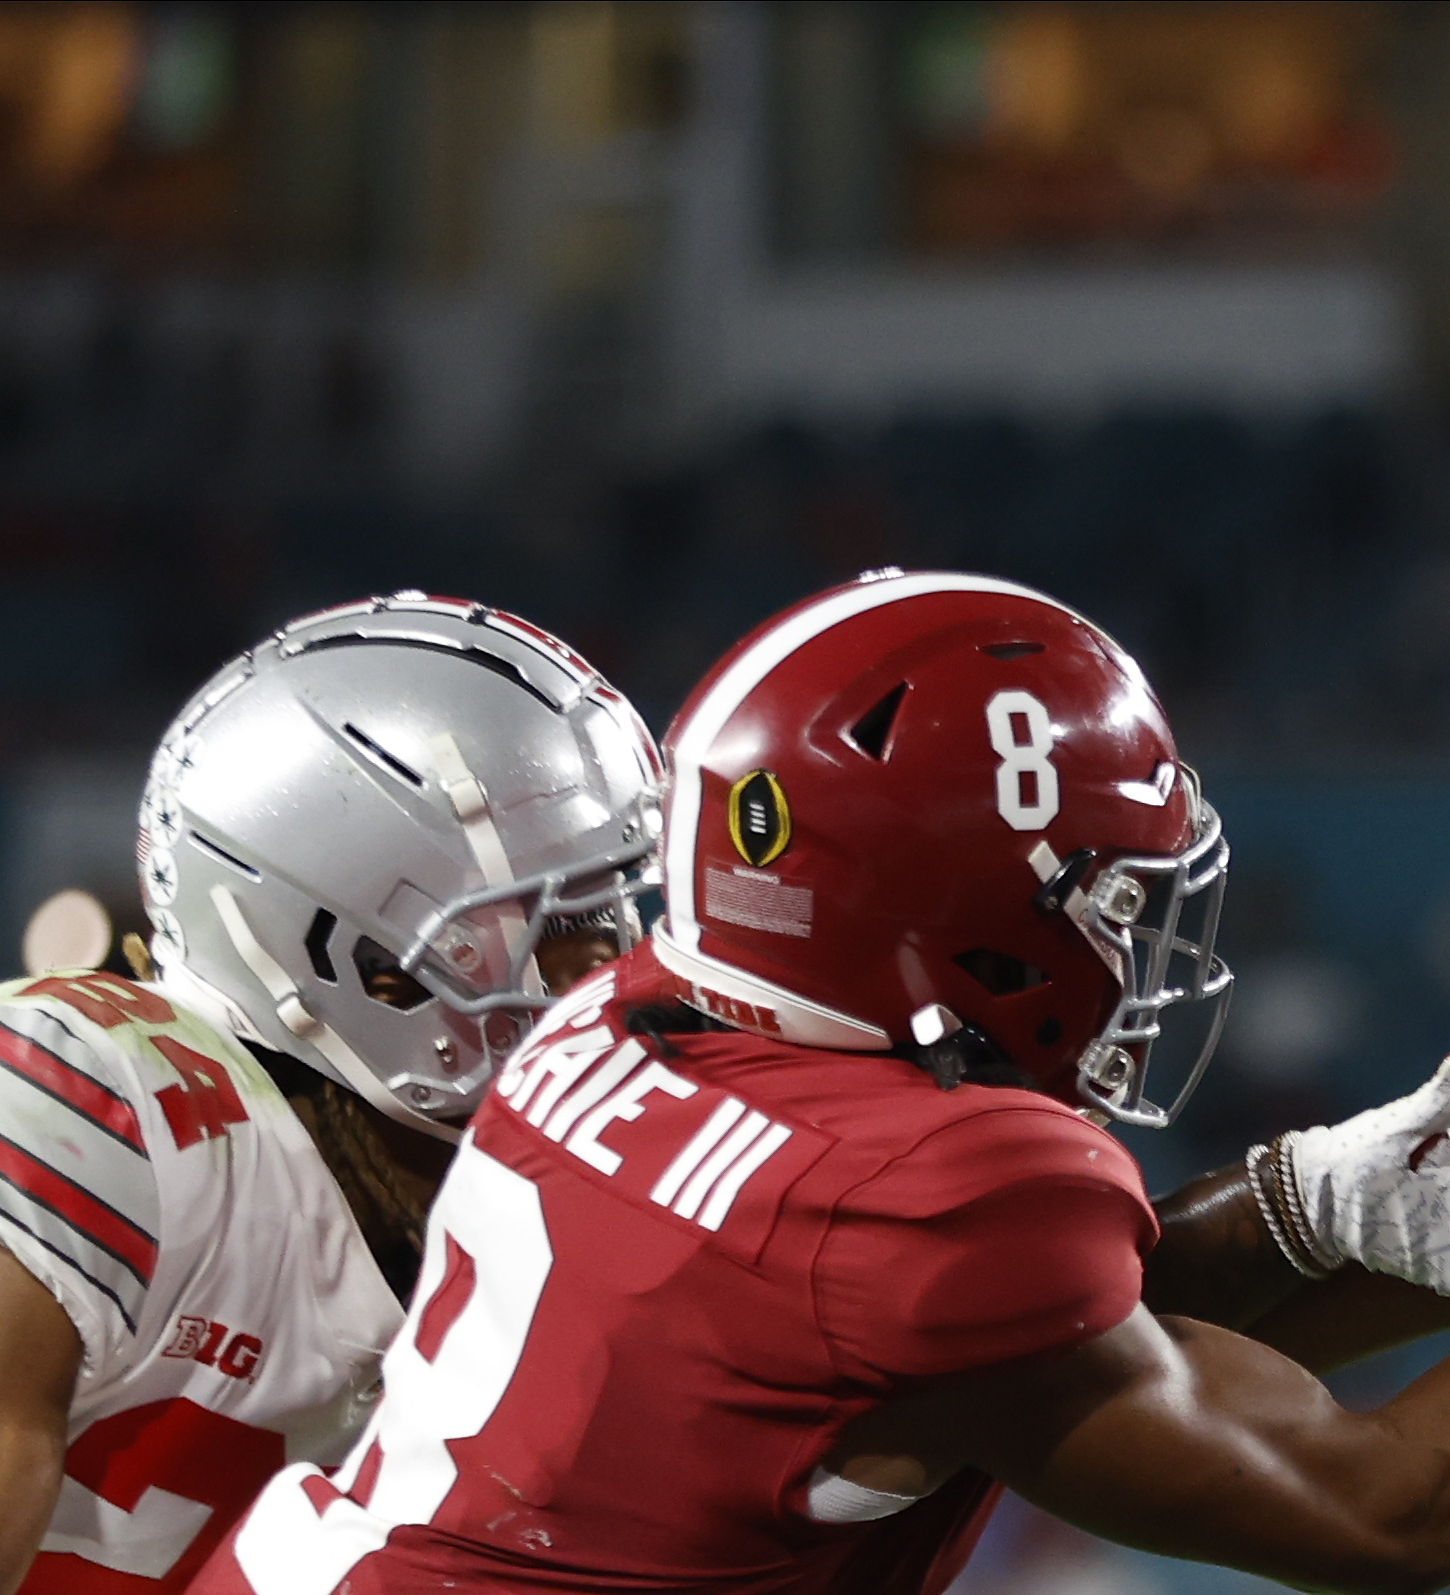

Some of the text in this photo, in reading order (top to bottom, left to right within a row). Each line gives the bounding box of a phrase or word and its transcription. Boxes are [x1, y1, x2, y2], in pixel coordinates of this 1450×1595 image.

[985, 690, 1060, 832] 8
[13, 970, 250, 1151] 24
[649, 1096, 794, 1233] III
